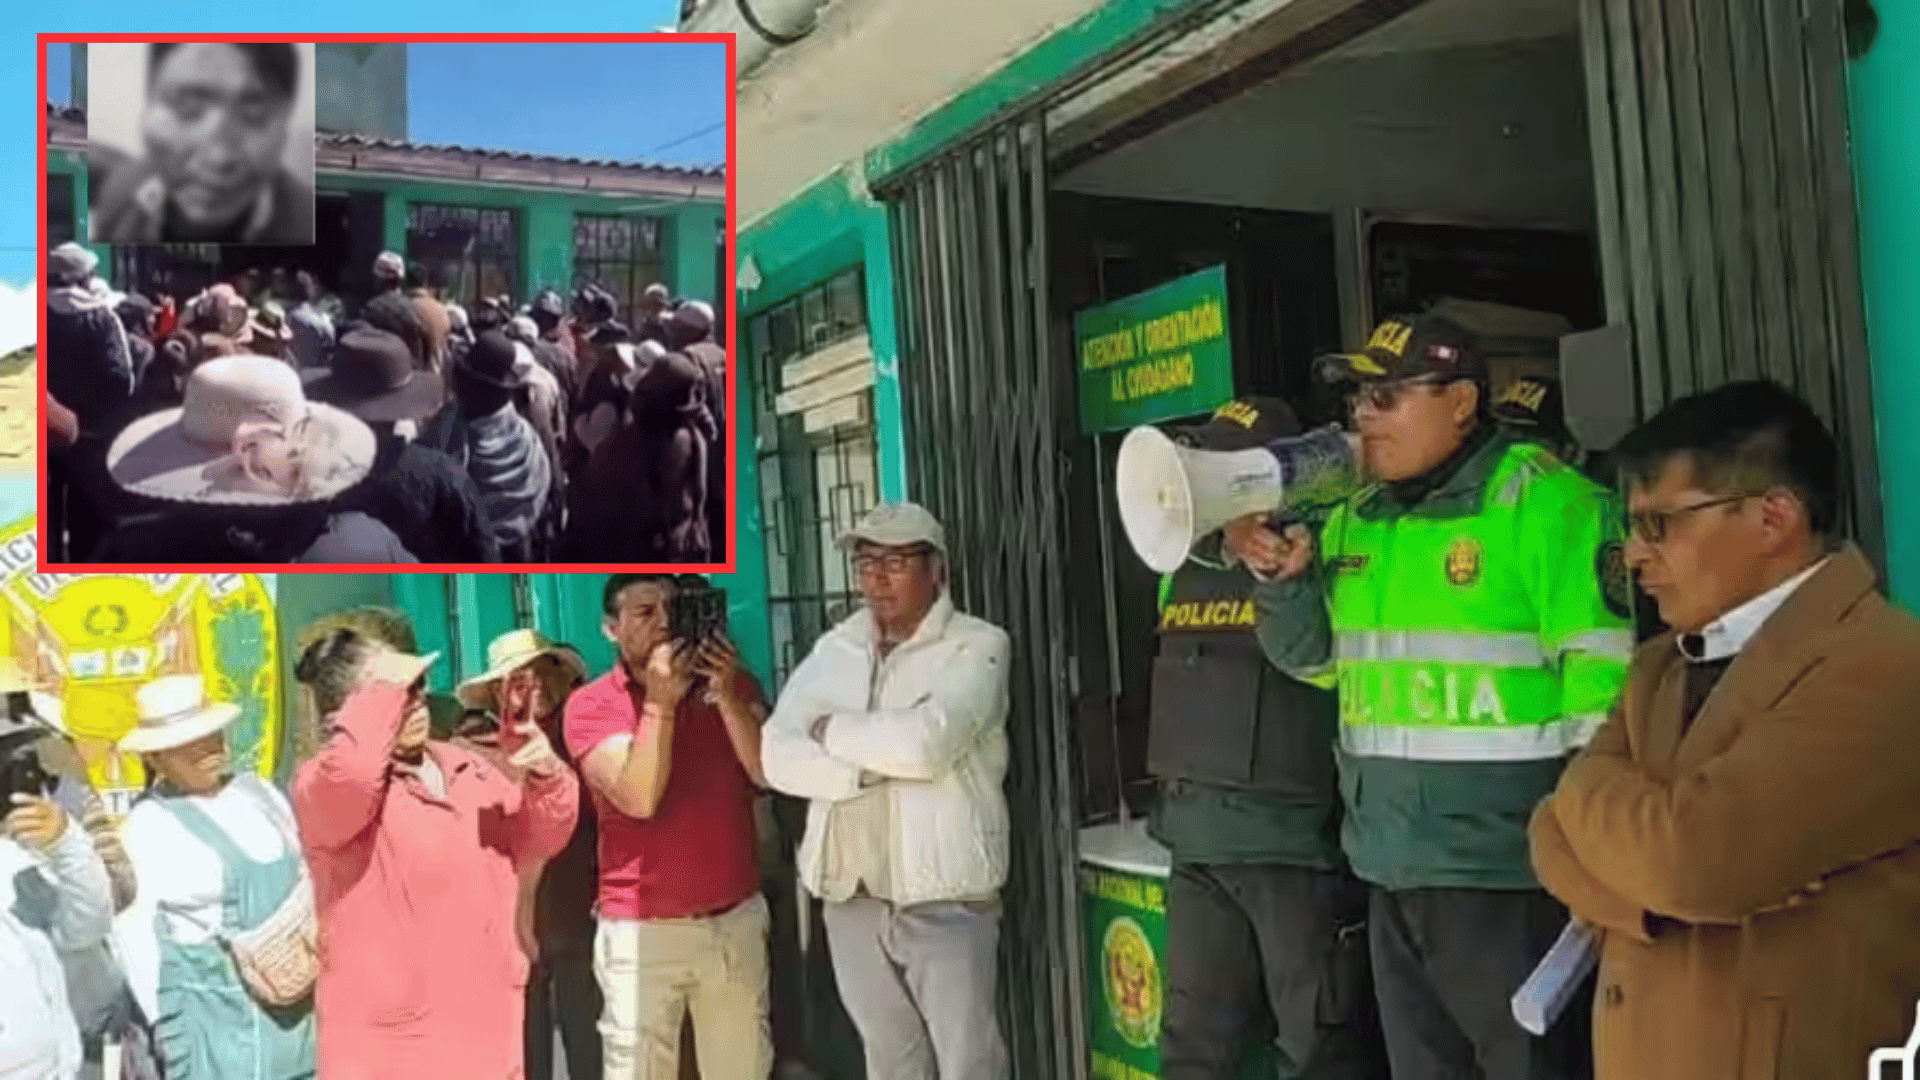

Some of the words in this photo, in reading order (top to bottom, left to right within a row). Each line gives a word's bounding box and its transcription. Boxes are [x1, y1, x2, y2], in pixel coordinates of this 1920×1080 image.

[1136, 322, 1144, 357] Y
[1112, 369, 1126, 400] AL
[1162, 600, 1255, 629] POLICIA
